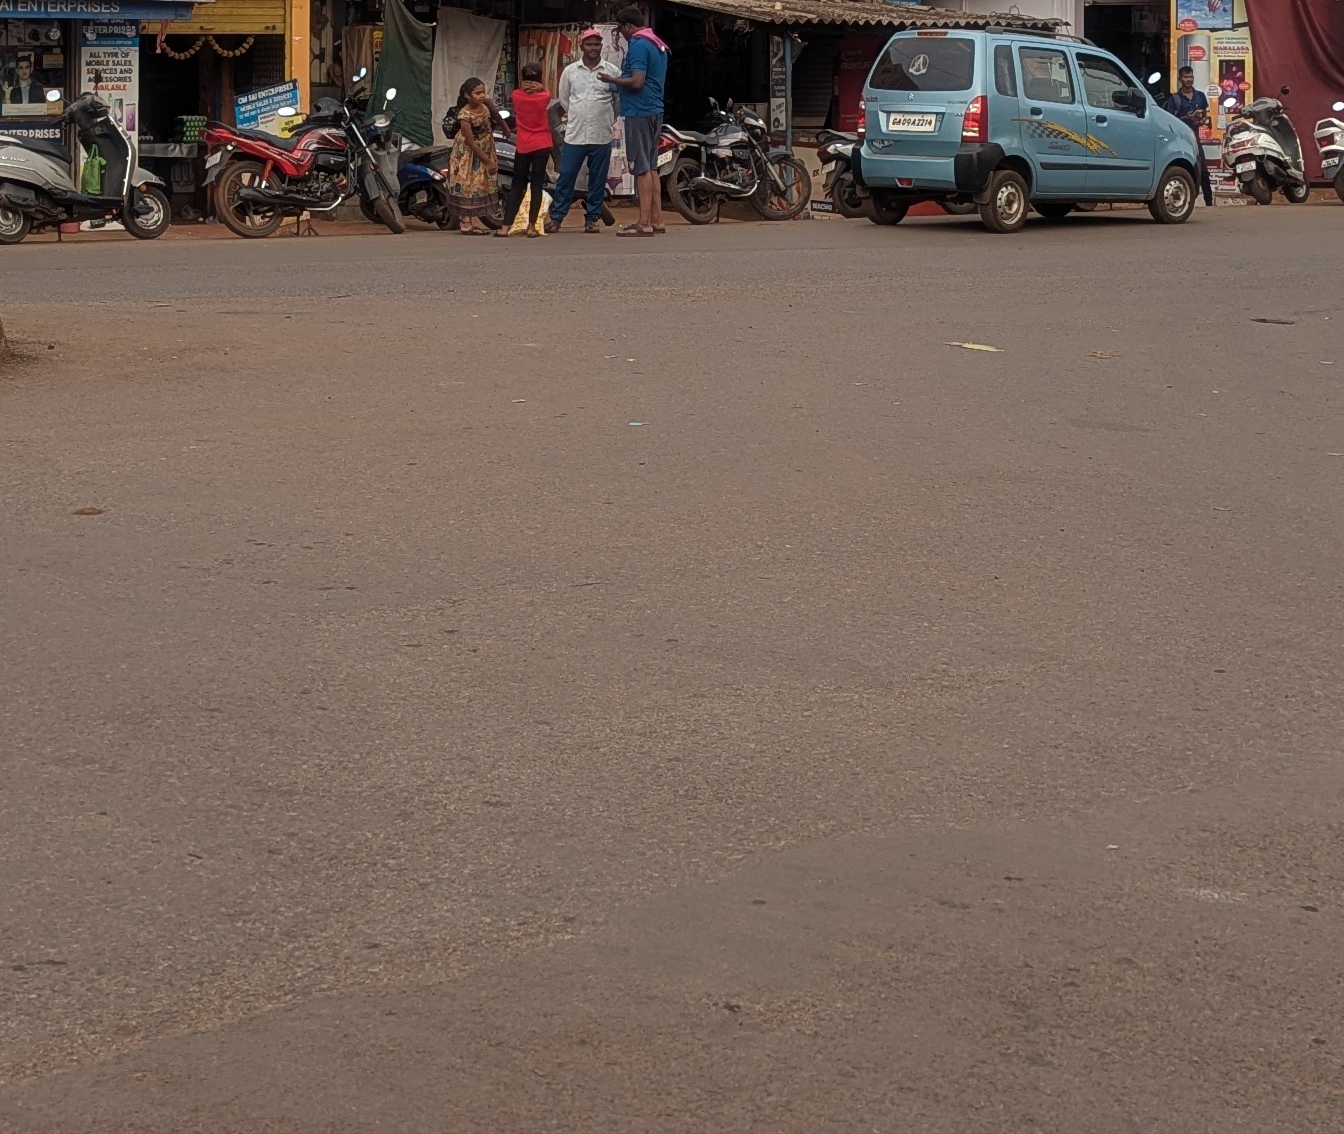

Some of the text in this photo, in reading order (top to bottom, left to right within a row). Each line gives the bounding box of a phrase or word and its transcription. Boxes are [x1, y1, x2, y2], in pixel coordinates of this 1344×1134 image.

[17, 0, 121, 13] ENTERPRISES
[89, 51, 131, 59] ALL TYPE OF
